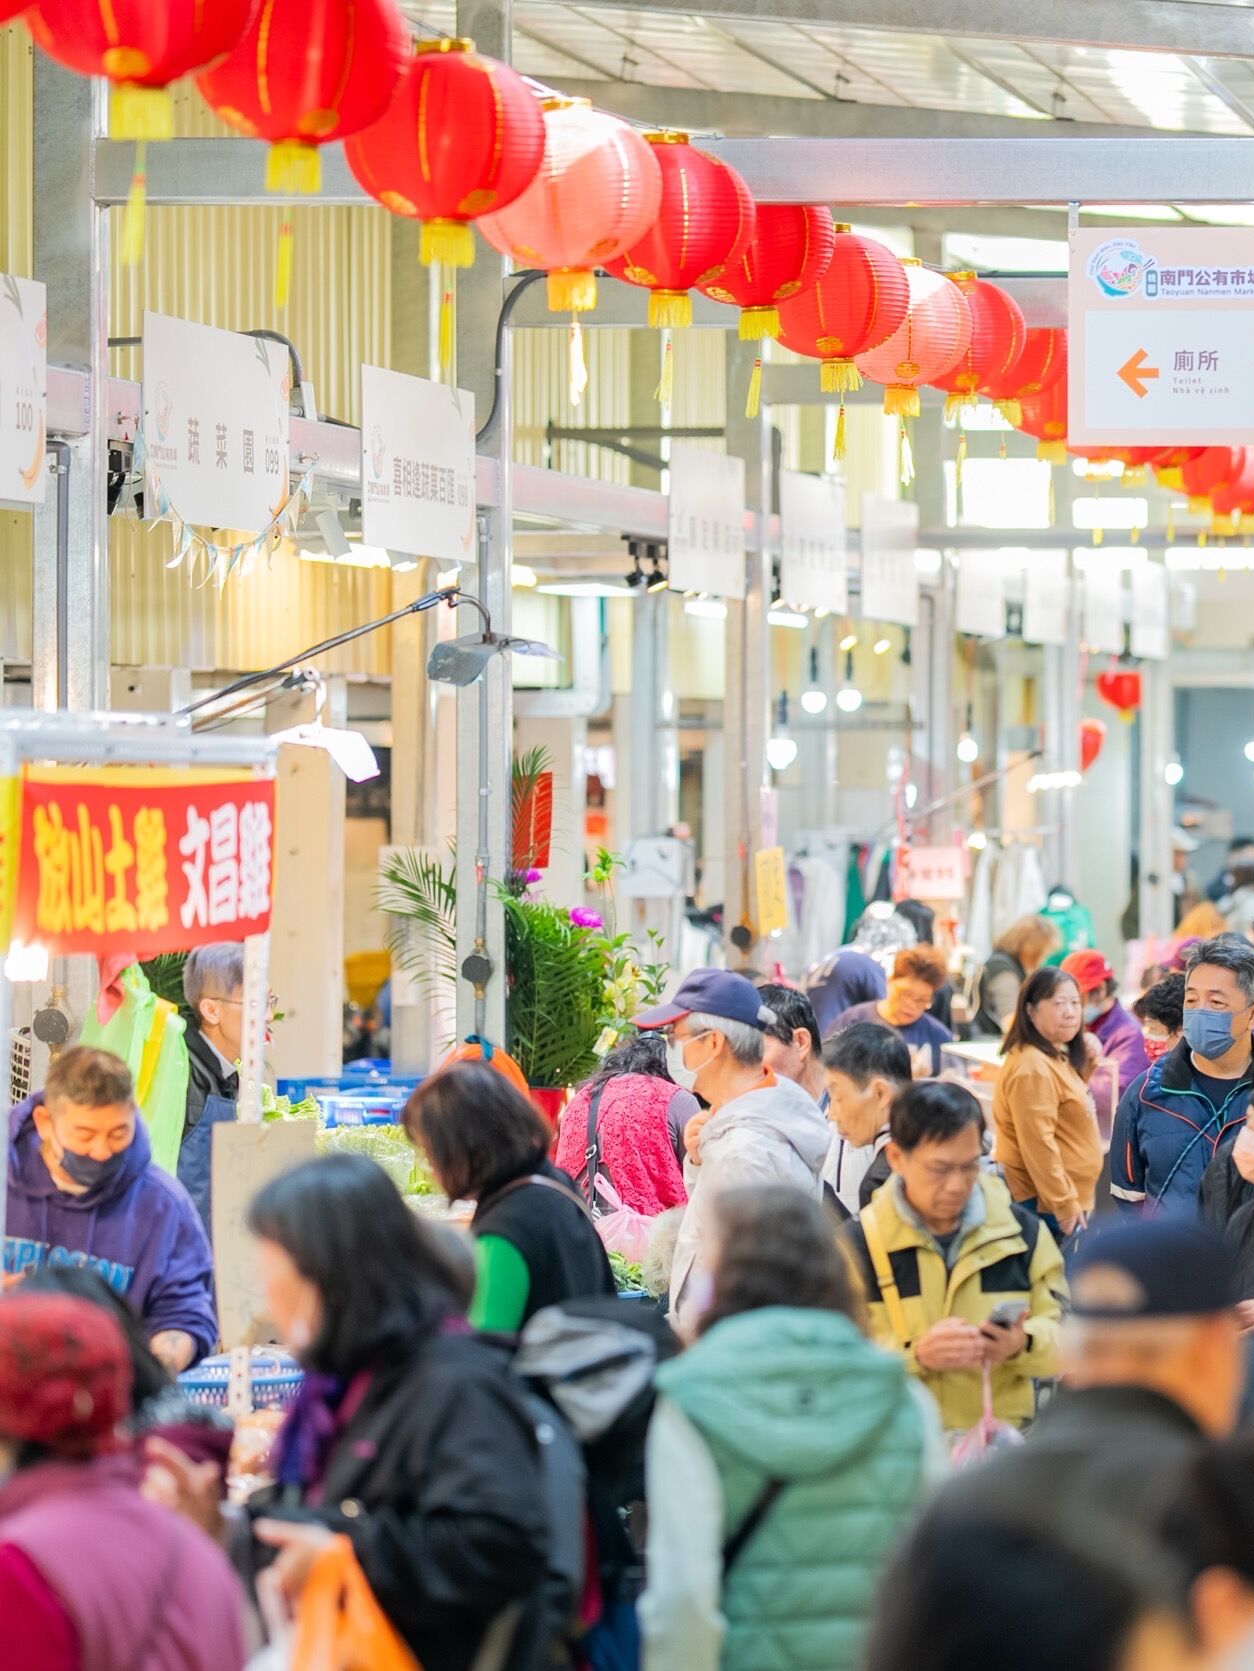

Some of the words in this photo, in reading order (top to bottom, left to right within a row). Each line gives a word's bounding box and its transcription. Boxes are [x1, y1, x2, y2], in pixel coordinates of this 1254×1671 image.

[1161, 288, 1194, 297] Taoyuan
[1197, 288, 1232, 296] Nanmen
[1173, 350, 1219, 372] 廁所
[16, 402, 33, 432] 100
[187, 417, 254, 476] 蔬菜園
[265, 448, 280, 475] 099
